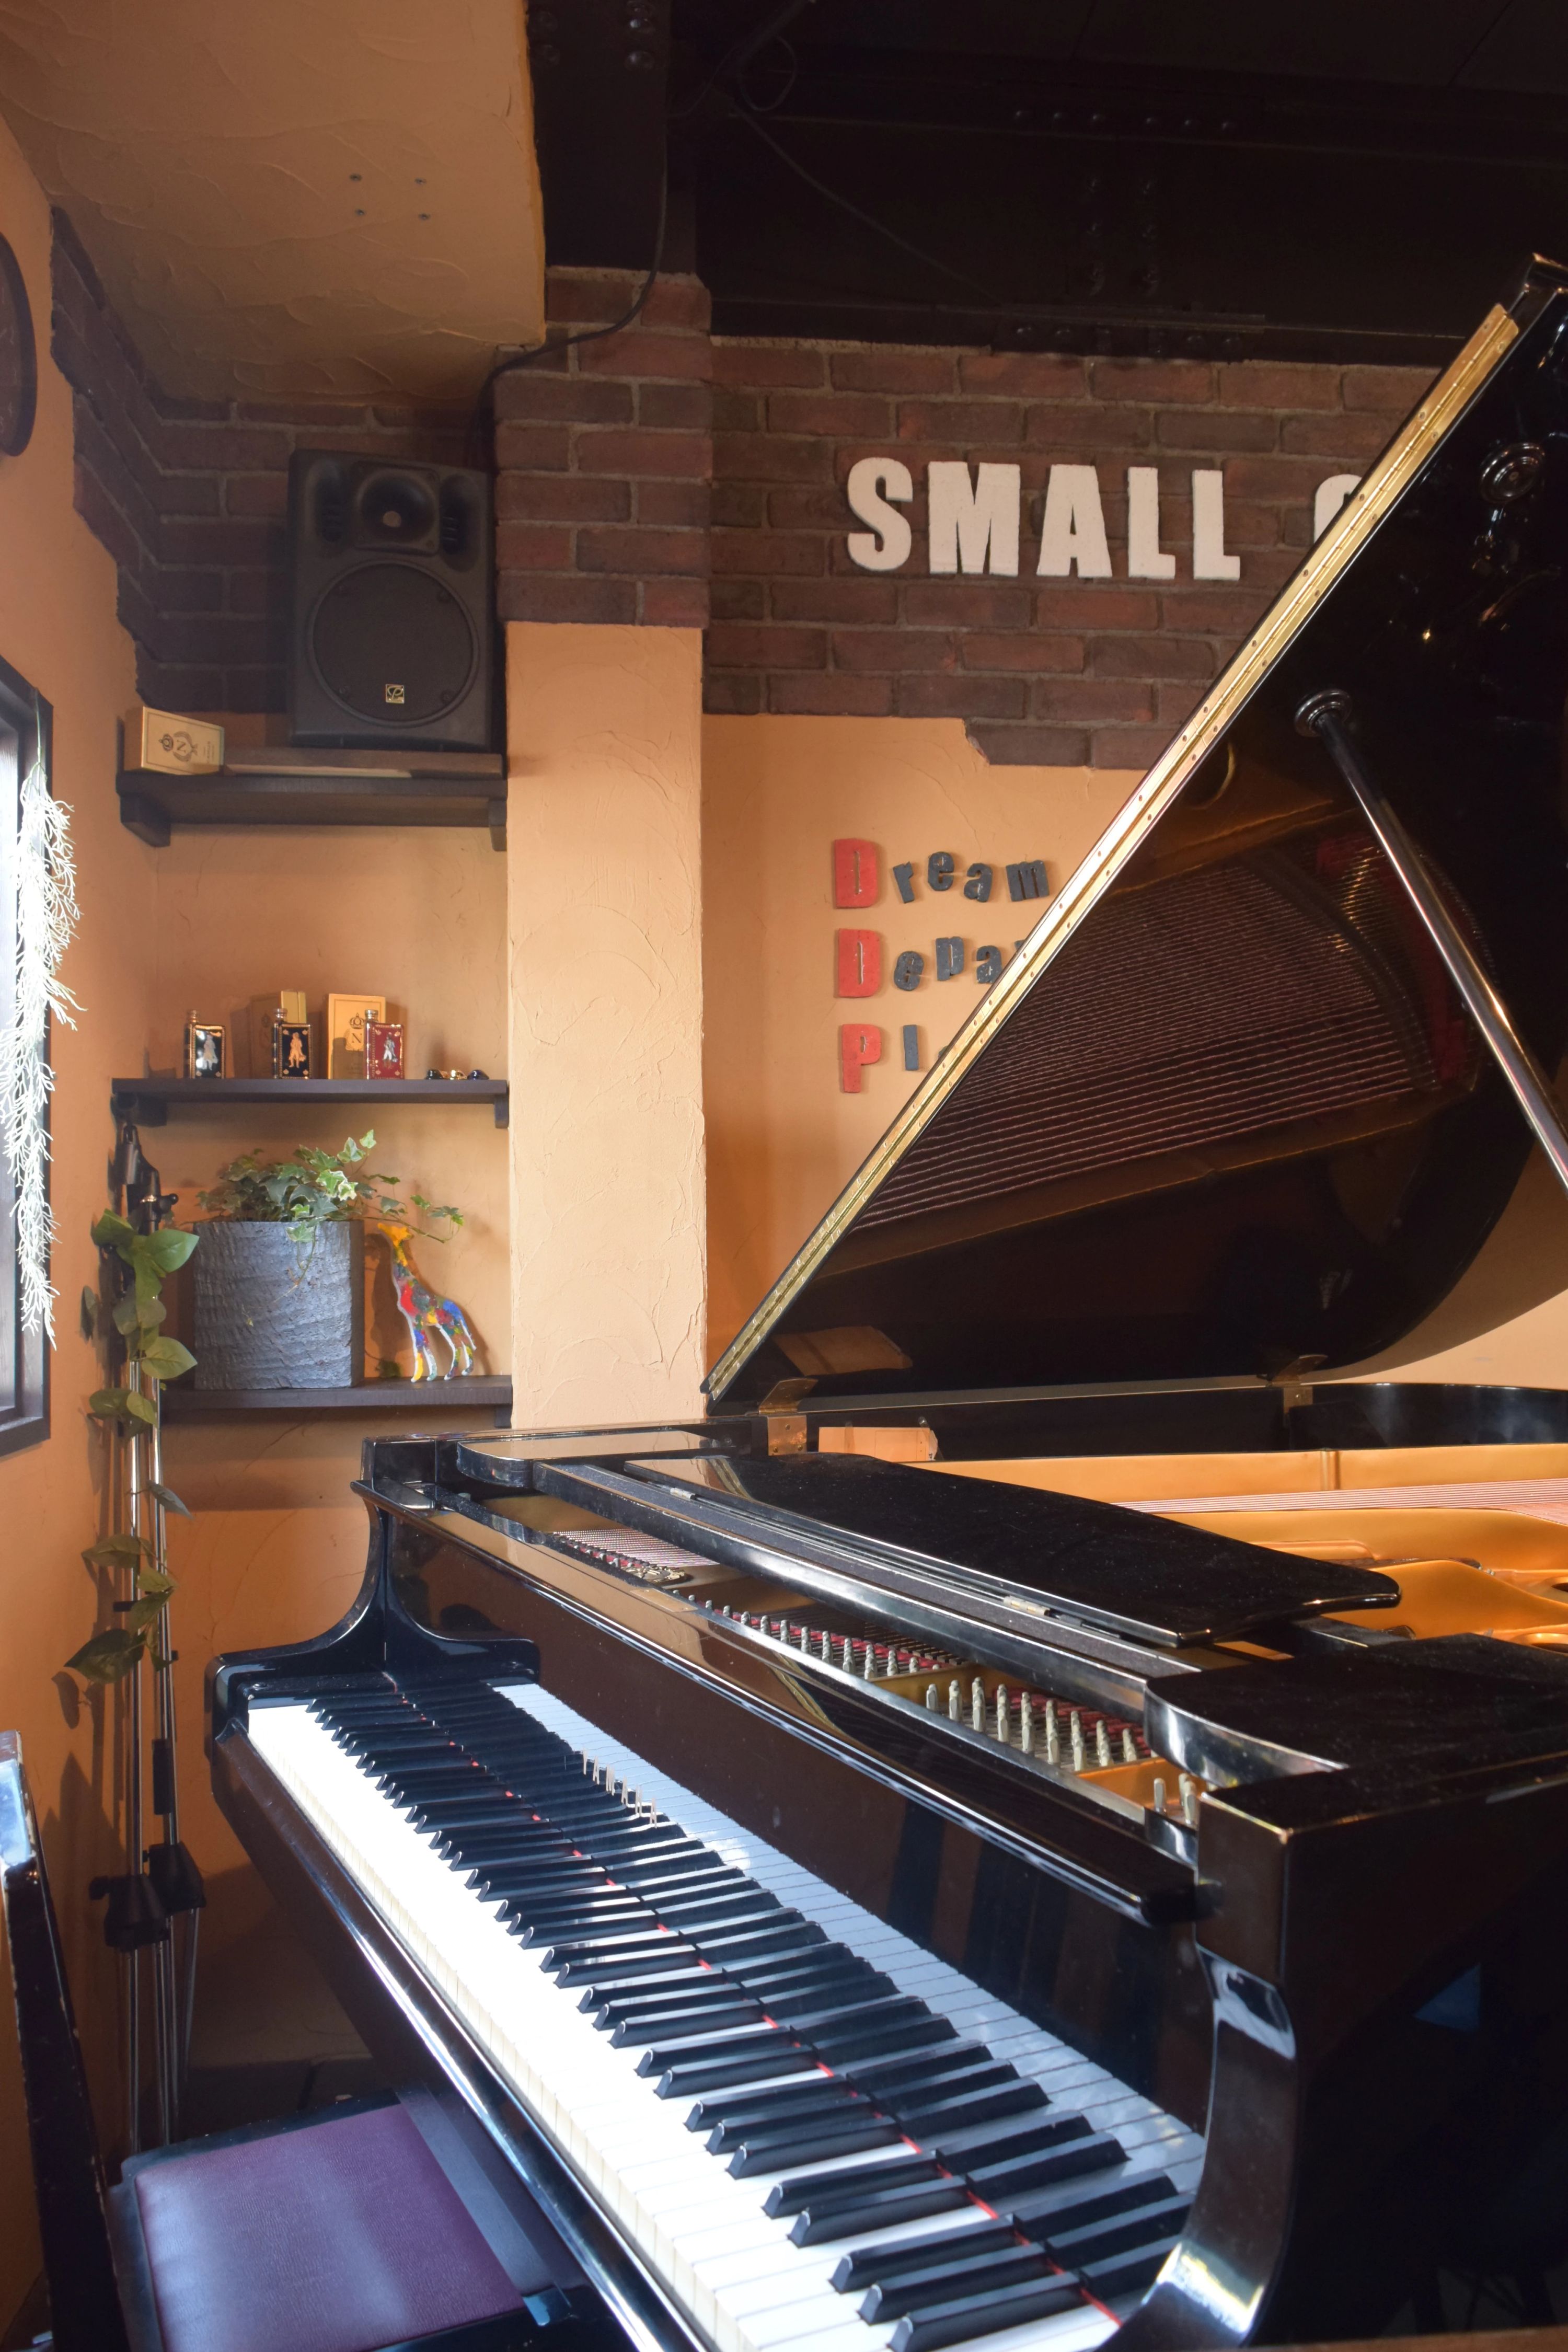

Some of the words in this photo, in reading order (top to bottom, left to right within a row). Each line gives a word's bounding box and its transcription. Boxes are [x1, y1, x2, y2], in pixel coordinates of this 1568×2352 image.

[847, 457, 1241, 581] SMALL
[834, 838, 1050, 908] Dream
[837, 928, 1026, 998] Depa
[352, 1033, 362, 1044] N
[841, 1023, 954, 1093] Pl
[582, 1747, 658, 1829] YAMAHA
